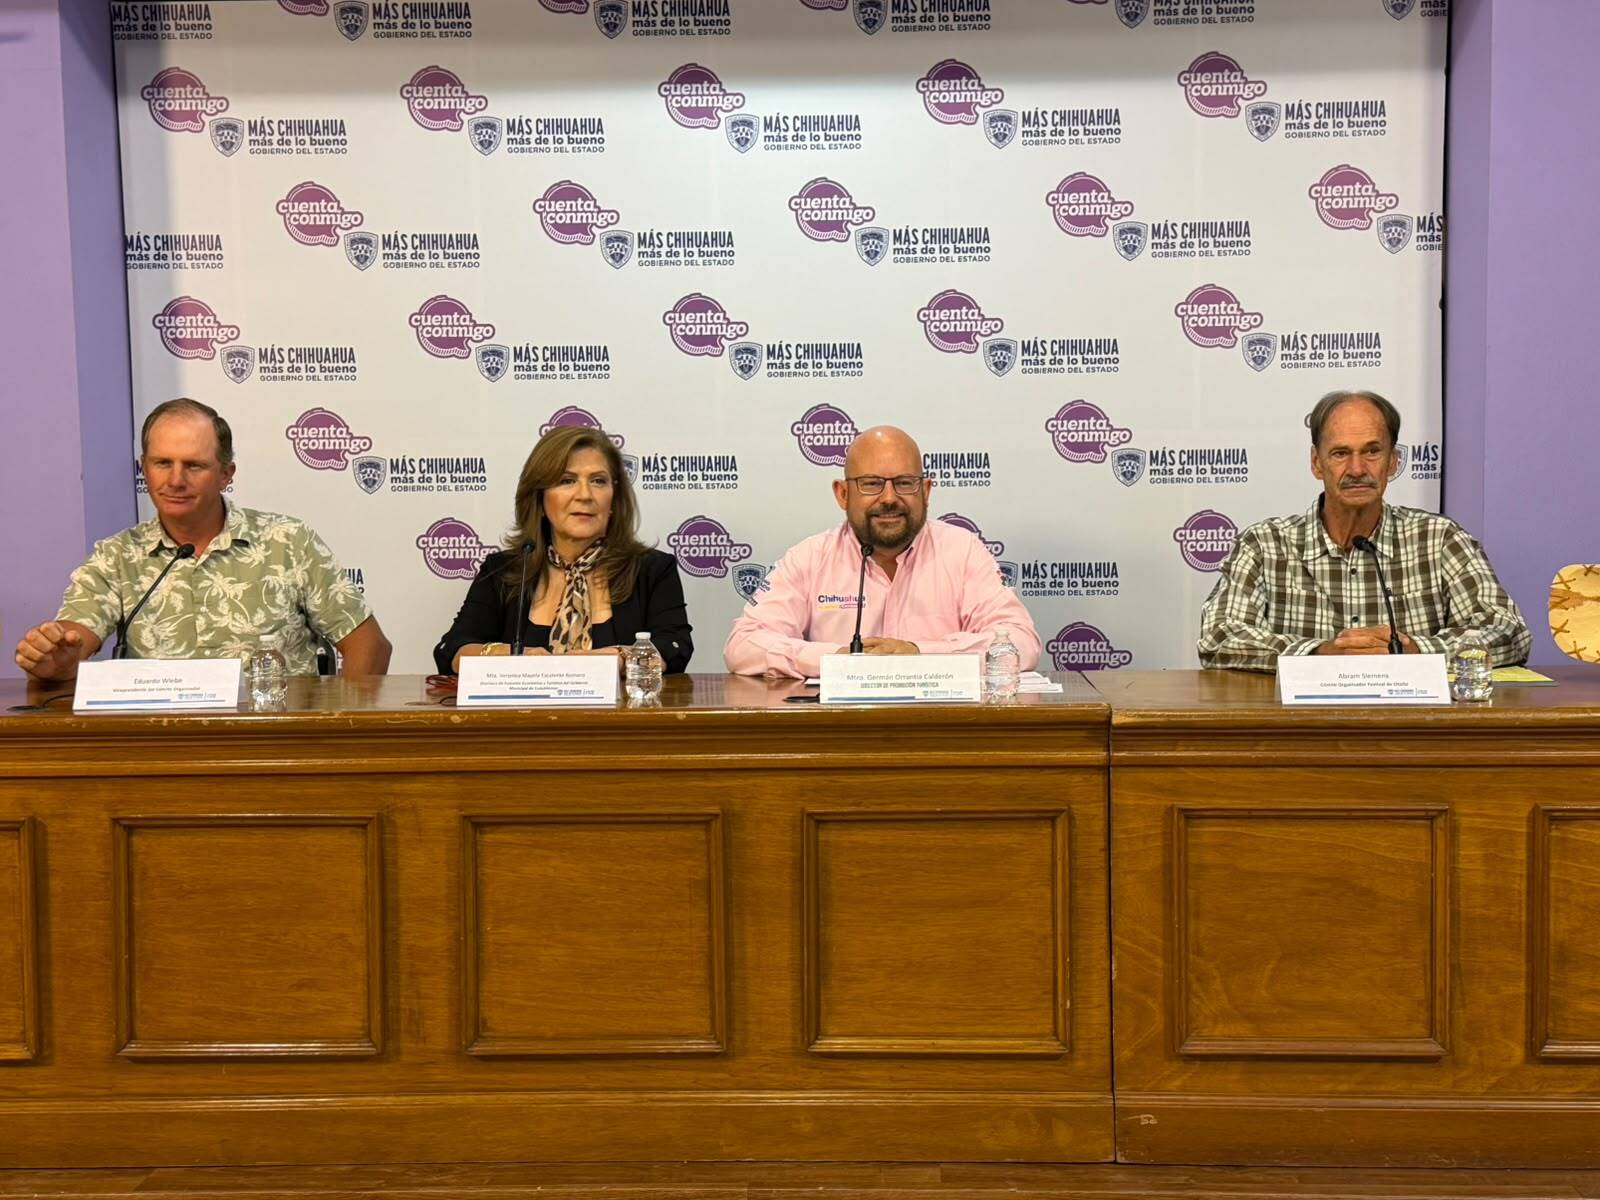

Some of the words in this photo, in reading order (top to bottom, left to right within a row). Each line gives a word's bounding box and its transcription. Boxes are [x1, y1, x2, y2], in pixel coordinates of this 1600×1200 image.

[142, 5, 211, 22] CHIHUAHUA
[372, 0, 399, 19] MÁS
[402, 2, 471, 20] CHIHUAHUA
[662, 0, 730, 17] CHIHUAHUA
[918, 76, 981, 91] cuenta
[1180, 69, 1244, 84] cuenta
[143, 85, 206, 98] cuenta
[402, 83, 464, 97] cuenta
[660, 81, 722, 94] cuenta
[1191, 83, 1264, 99] conmigo
[414, 98, 485, 112] conmigo
[672, 96, 742, 110] conmigo
[930, 91, 1001, 106] conmigo
[155, 99, 227, 114] conmigo
[1285, 99, 1312, 120] MÁS
[1316, 100, 1386, 119] CHIHUAHUA
[764, 112, 789, 132] MÁS
[793, 114, 860, 132] CHIHUAHUA
[1022, 107, 1048, 127] MÁS
[1052, 108, 1120, 126] CHIHUAHUA
[248, 116, 274, 136] MÁS
[278, 119, 346, 136] CHIHUAHUA
[506, 115, 532, 135] MÁS
[536, 117, 604, 135] CHIHUAHUA
[764, 132, 788, 142] más
[792, 132, 806, 142] de
[810, 132, 820, 142] lo
[824, 132, 862, 142] bueno
[1048, 190, 1111, 204] cuenta
[1311, 182, 1375, 197] cuenta
[278, 199, 340, 213] cuenta
[535, 198, 596, 211] cuenta
[791, 195, 852, 208] cuenta
[1322, 196, 1396, 212] conmigo
[547, 212, 617, 226] conmigo
[802, 209, 872, 224] conmigo
[1059, 204, 1131, 219] conmigo
[290, 213, 361, 228] conmigo
[893, 225, 918, 245] MÁS
[922, 227, 990, 244] CHIHUAHUA
[1151, 219, 1178, 239] MÁS
[1181, 220, 1251, 239] CHIHUAHUA
[154, 234, 222, 251] CHIHUAHUA
[382, 230, 408, 250] MÁS
[411, 233, 479, 250] CHIHUAHUA
[638, 229, 663, 248] MÁS
[667, 231, 734, 248] CHIHUAHUA
[1152, 239, 1176, 249] más
[1180, 239, 1195, 248] de
[1198, 239, 1209, 248] lo
[1213, 239, 1251, 248] bueno
[1416, 232, 1441, 242] más
[919, 306, 981, 320] cuenta
[1177, 301, 1240, 315] cuenta
[155, 313, 217, 327] cuenta
[411, 312, 472, 325] cuenta
[665, 310, 726, 323] cuenta
[1188, 315, 1260, 330] conmigo
[166, 327, 238, 342] conmigo
[423, 326, 493, 340] conmigo
[676, 324, 746, 338] conmigo
[930, 320, 1001, 335] conmigo
[1021, 337, 1047, 356] MÁS
[1051, 338, 1118, 355] CHIHUAHUA
[1281, 331, 1308, 350] MÁS
[1311, 332, 1381, 350] CHIHUAHUA
[258, 344, 284, 363] MÁS
[288, 346, 356, 364] CHIHUAHUA
[513, 343, 539, 362] MÁS
[542, 345, 609, 362] CHIHUAHUA
[767, 340, 792, 360] MÁS
[796, 342, 862, 359] CHIHUAHUA
[260, 364, 284, 373] más
[287, 364, 302, 373] de
[305, 364, 316, 373] lo
[319, 364, 357, 373] bueno
[793, 420, 854, 434] cuenta
[1047, 417, 1109, 430] cuenta
[288, 425, 349, 438] cuenta
[1058, 431, 1129, 445] conmigo
[299, 438, 370, 453] conmigo
[803, 434, 854, 446] conmi
[1149, 446, 1176, 466] MÁS
[1179, 448, 1248, 465] CHIHUAHUA
[1412, 442, 1438, 462] MÁS
[390, 455, 415, 474] MÁS
[419, 457, 486, 474] CHIHUAHUA
[642, 453, 667, 472] MÁS
[671, 455, 737, 472] CHIHUAHUA
[924, 452, 990, 469] CHIHUAHUA
[1412, 461, 1436, 471] más
[670, 532, 729, 545] cuenta
[1176, 526, 1235, 540] cuenta
[418, 534, 480, 548] cuenta
[1187, 540, 1232, 552] conm
[681, 546, 749, 560] conmigo
[1022, 560, 1047, 578] MÁS
[1051, 562, 1118, 578] CHIHUAHUA
[1022, 579, 1046, 588] más
[1049, 579, 1064, 588] de
[1067, 579, 1078, 588] lo
[1082, 579, 1119, 588] bueno
[1048, 639, 1111, 652] cuenta
[1060, 652, 1129, 667] conmigo
